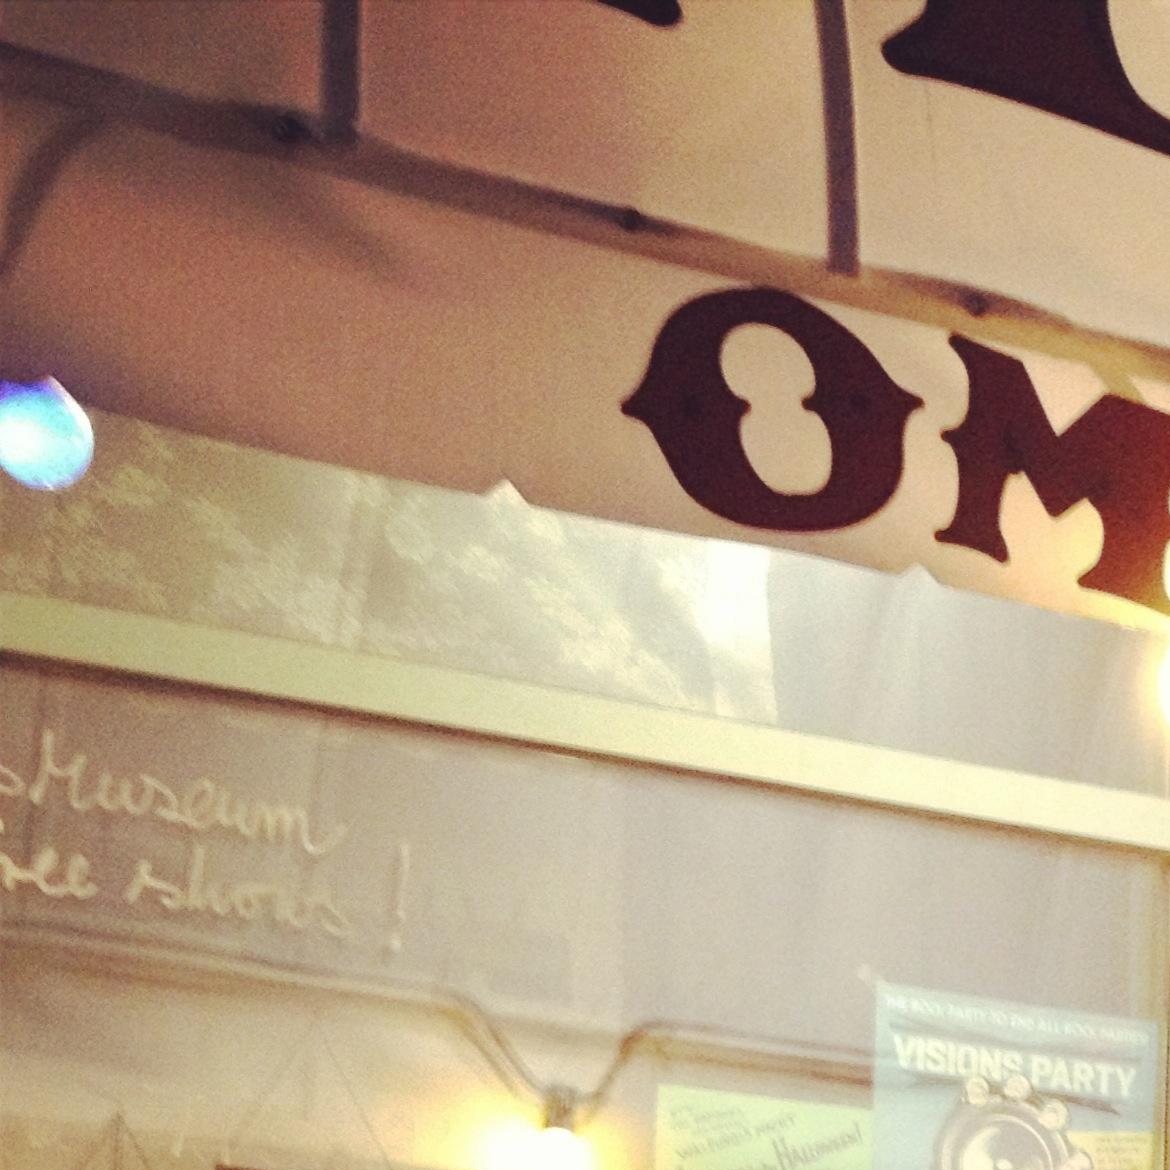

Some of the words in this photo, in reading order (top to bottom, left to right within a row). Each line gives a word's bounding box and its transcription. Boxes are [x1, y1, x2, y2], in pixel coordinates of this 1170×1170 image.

[30, 729, 348, 857] Museum
[0, 846, 98, 901] ree
[892, 1032, 1023, 1082] VISIONS
[1030, 1053, 1137, 1098] PARTY
